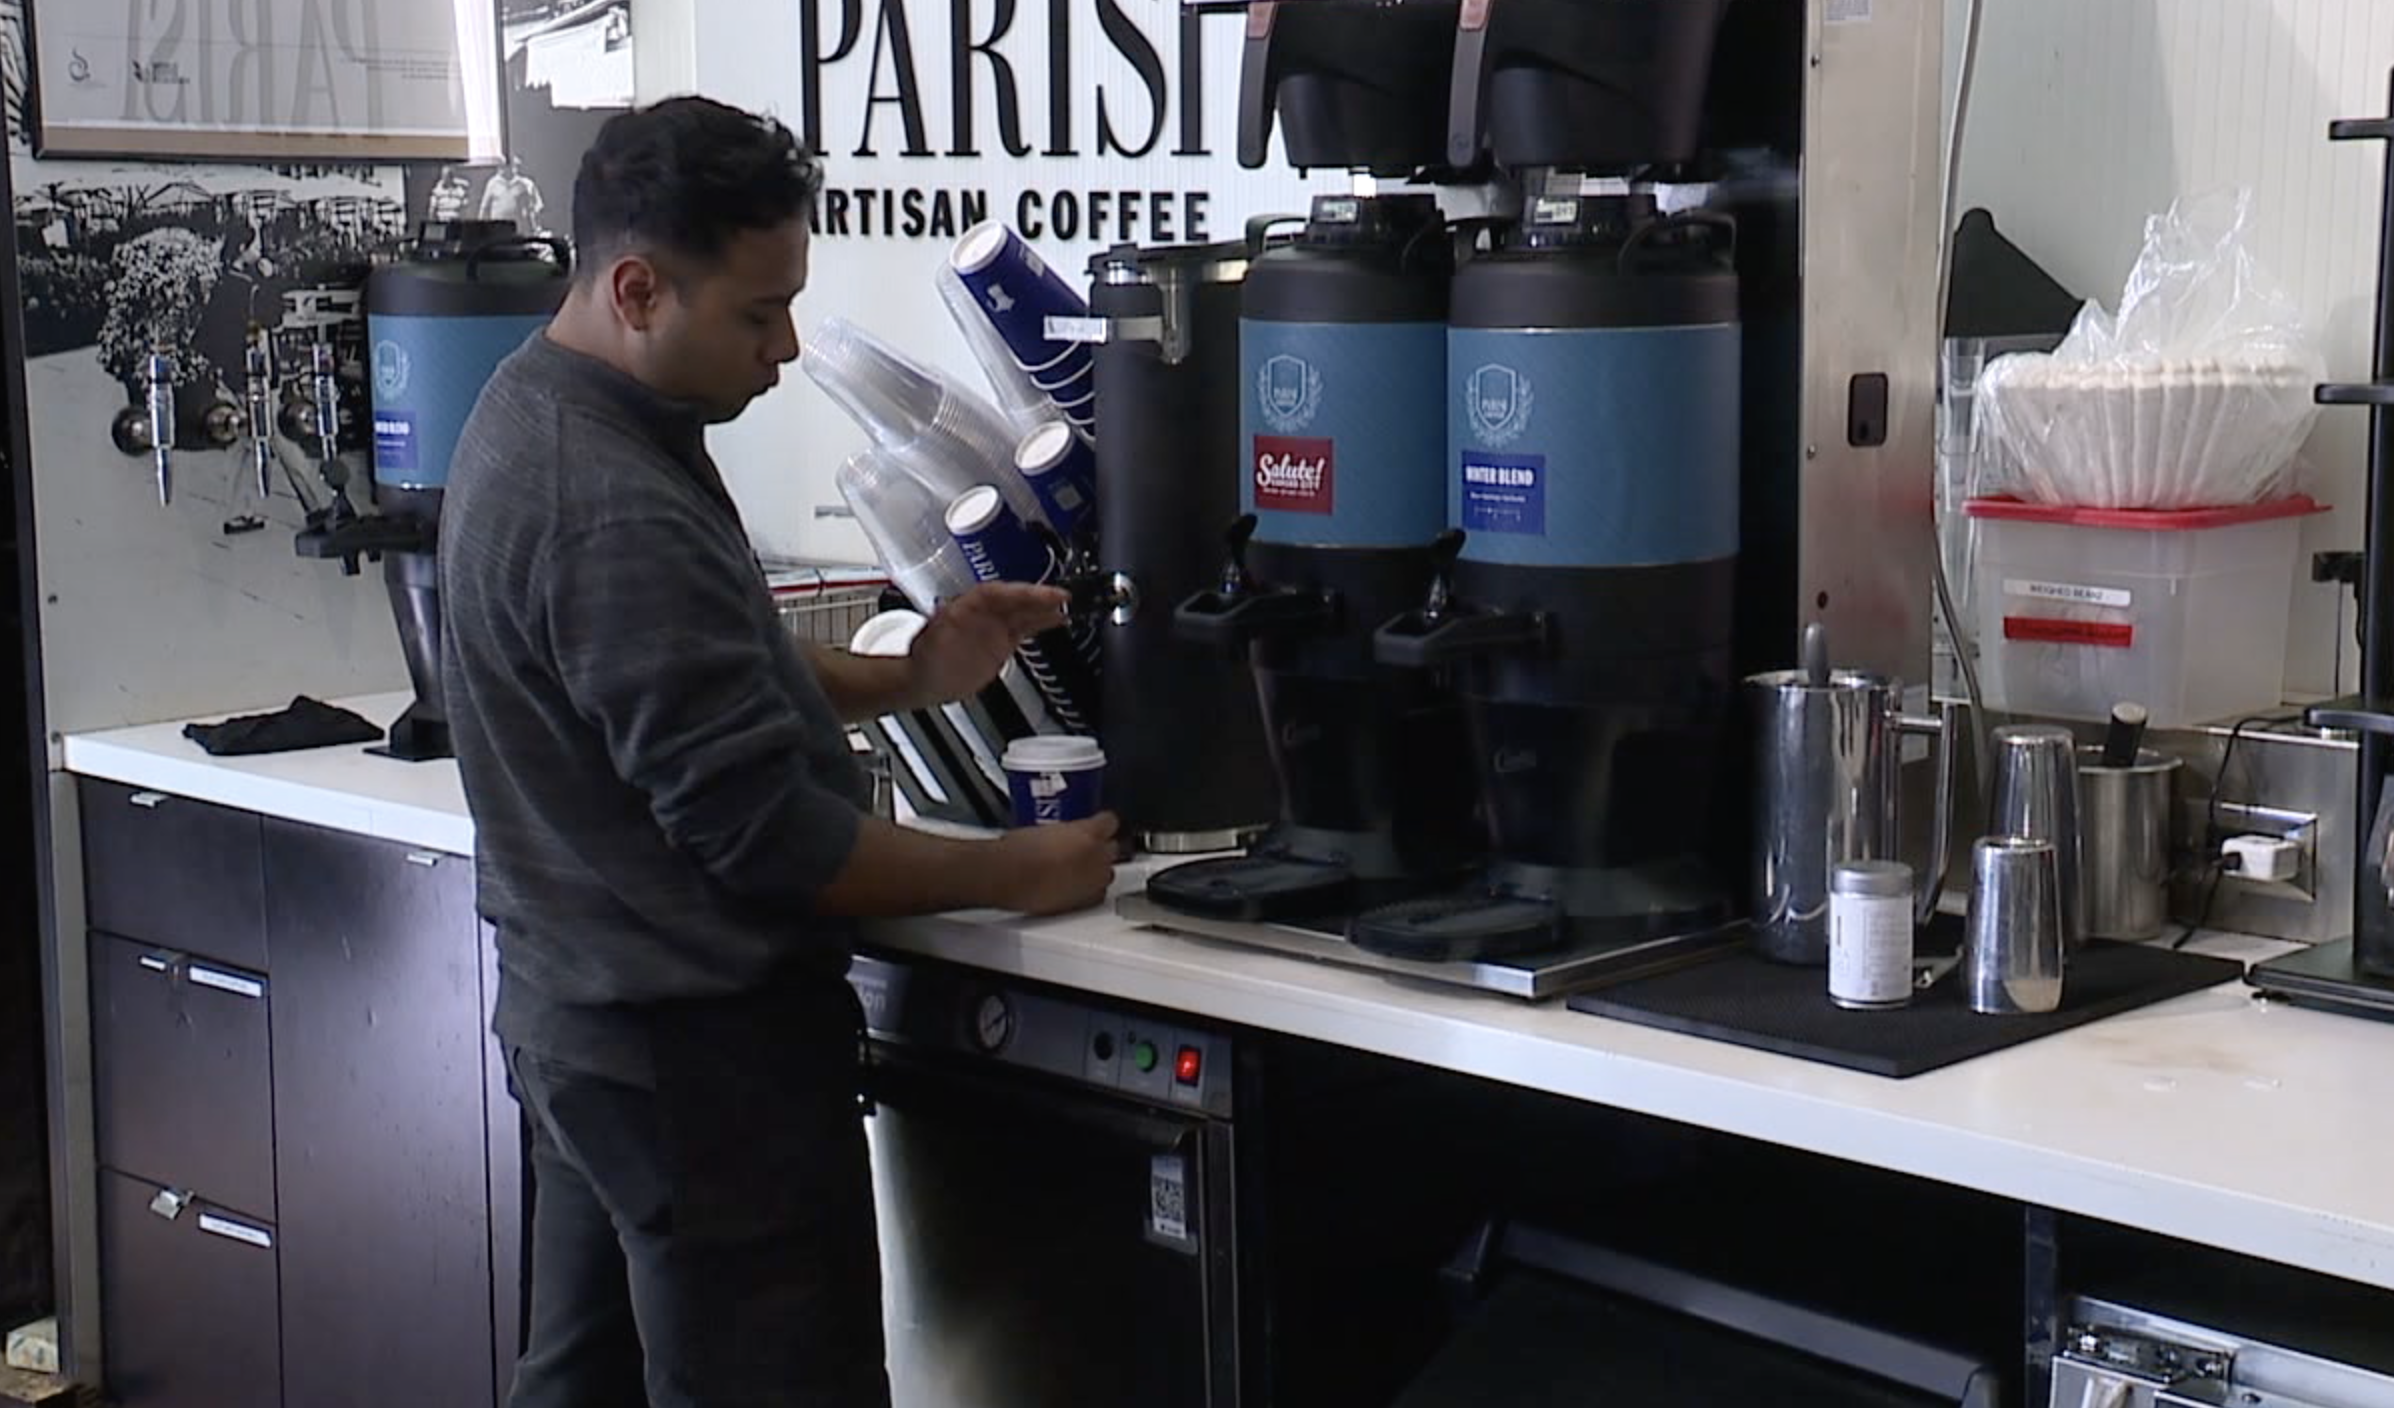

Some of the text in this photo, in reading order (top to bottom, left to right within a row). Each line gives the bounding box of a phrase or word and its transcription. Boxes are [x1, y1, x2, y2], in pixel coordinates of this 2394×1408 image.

[800, 0, 1211, 158] PARISI
[1017, 190, 1210, 242] COFFEE
[1256, 453, 1325, 490] Salute!
[1498, 467, 1534, 487] BLEND
[961, 541, 1000, 581] PARI
